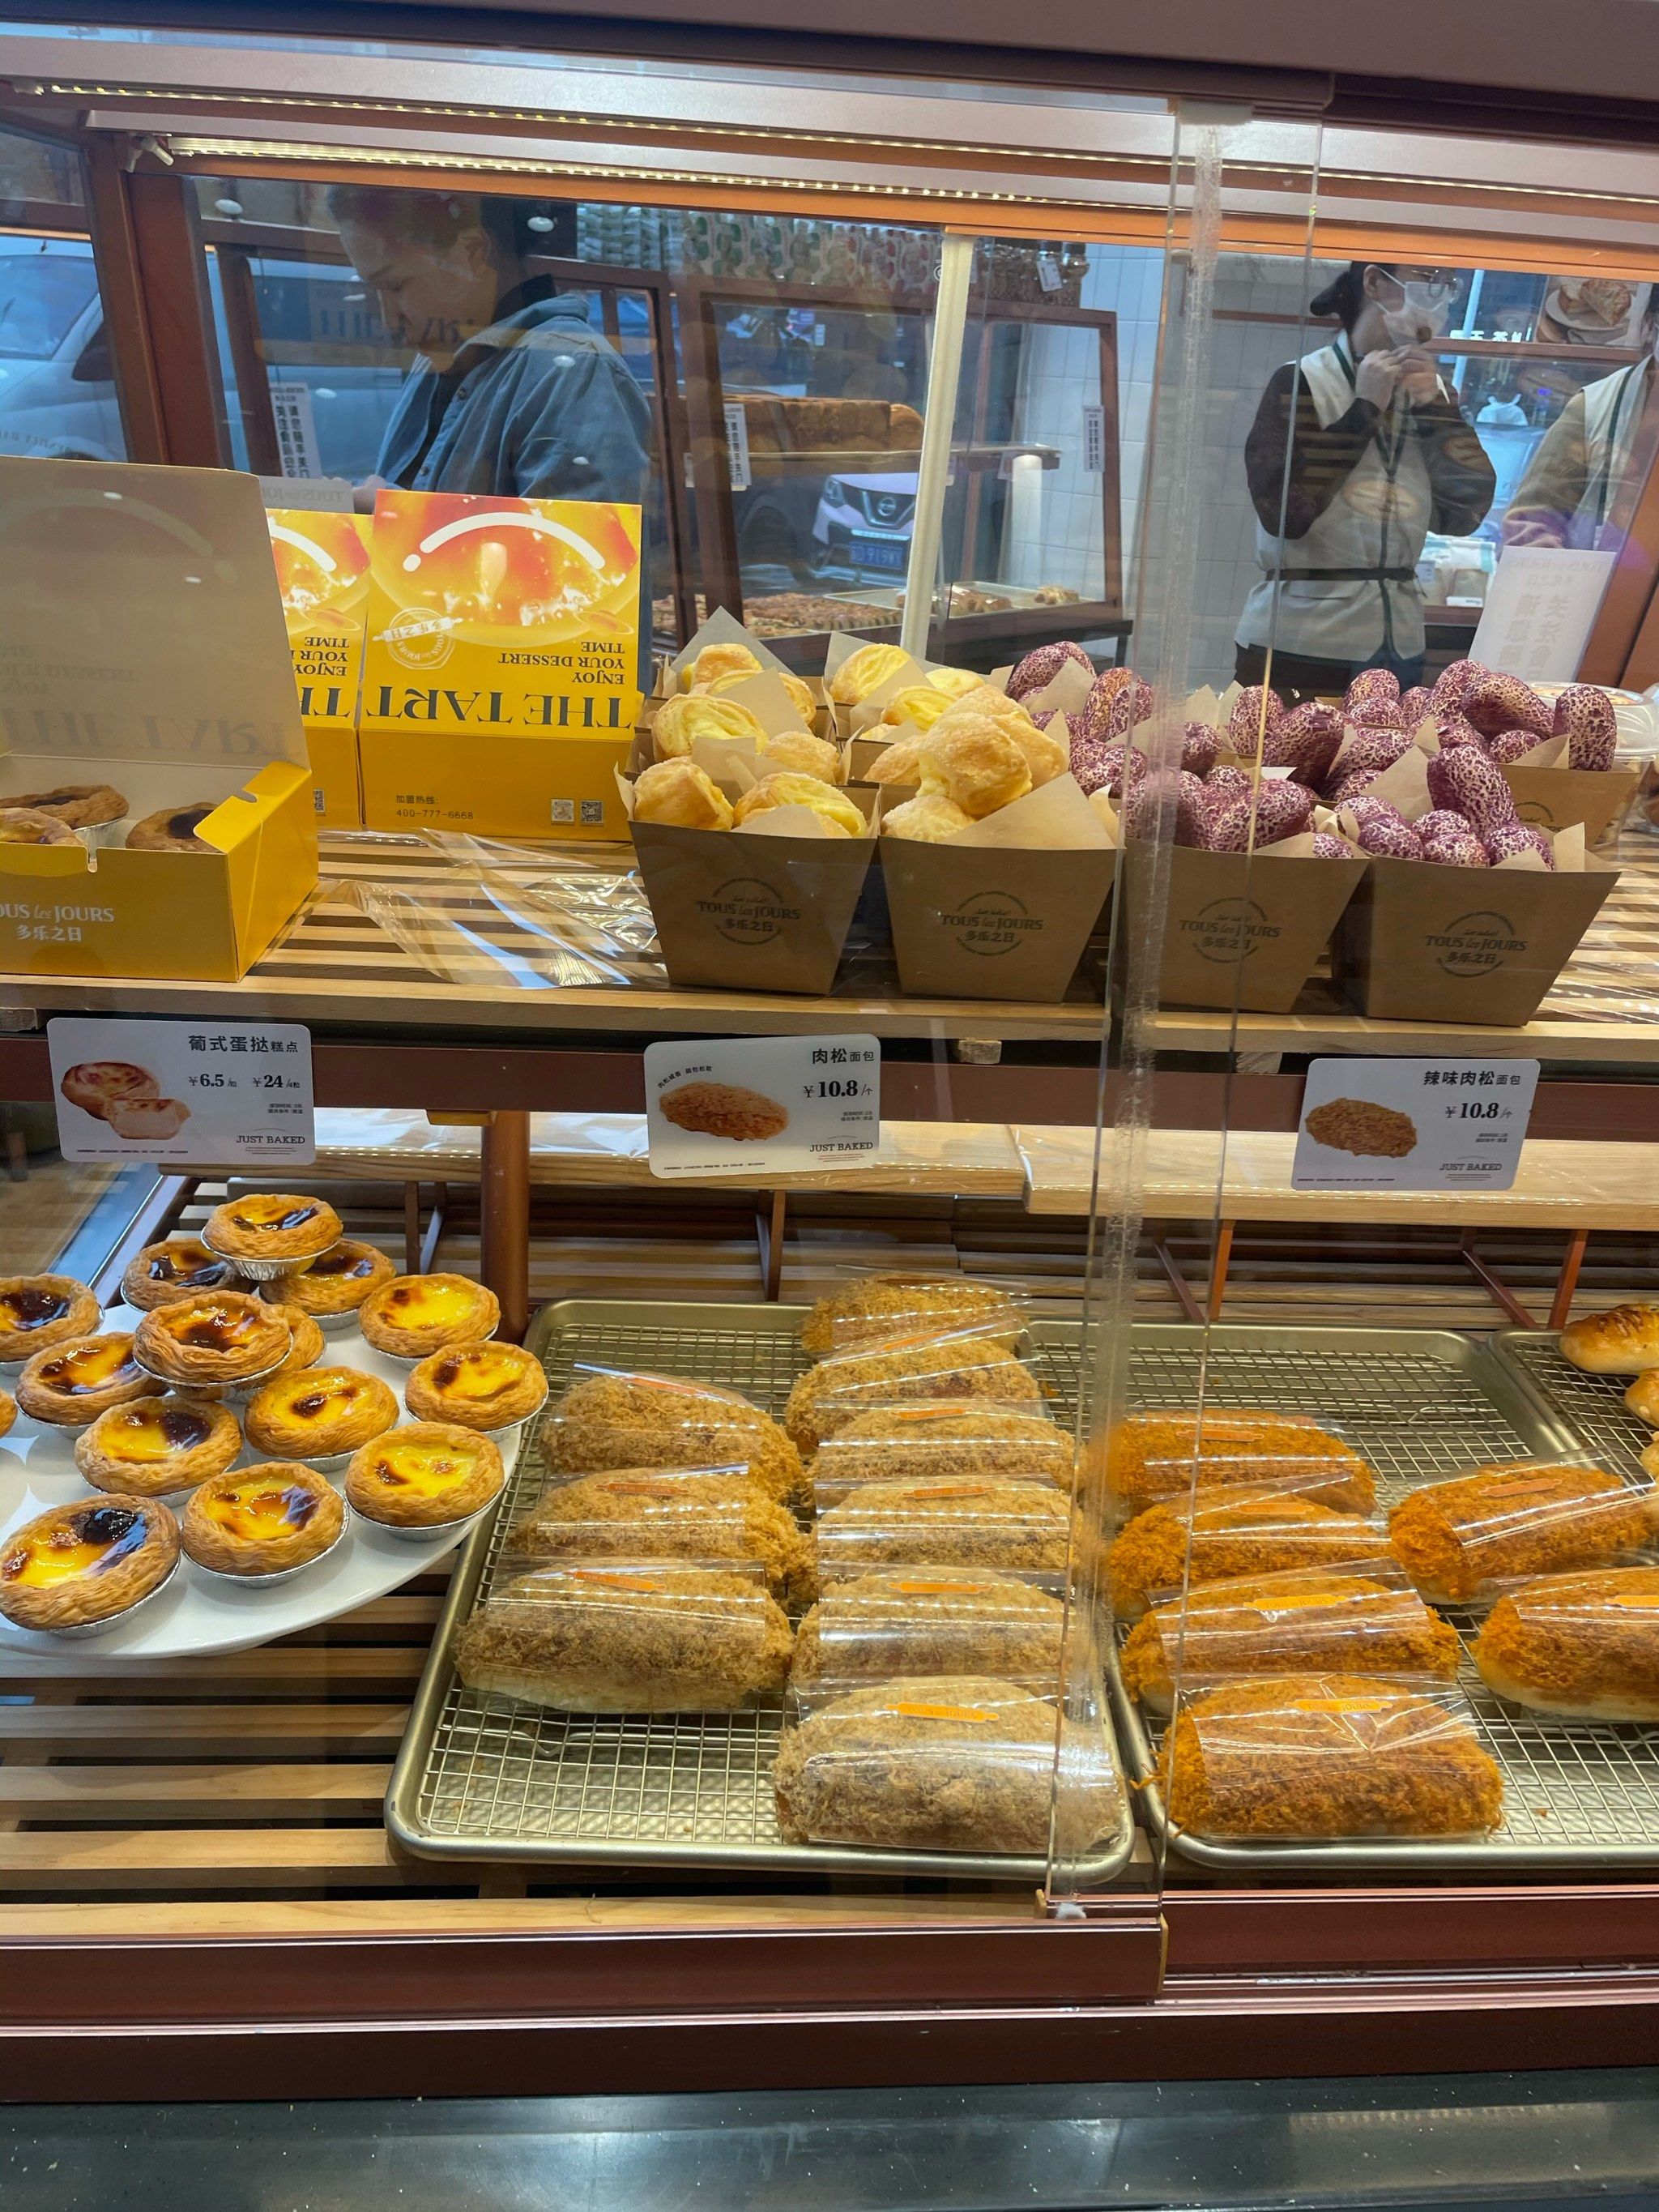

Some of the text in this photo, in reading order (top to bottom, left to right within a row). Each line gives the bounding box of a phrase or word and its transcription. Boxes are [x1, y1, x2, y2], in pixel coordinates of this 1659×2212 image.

[305, 636, 350, 648] TIME
[581, 641, 625, 654] TIME
[300, 650, 348, 662] YOUR
[498, 652, 625, 669] YOUR DESSERT
[572, 670, 625, 685] ENJOY
[366, 685, 513, 724] TART
[523, 693, 632, 729] THE
[395, 809, 475, 820] 400-777-6668
[34, 904, 52, 920] les
[53, 905, 115, 923] JOURS
[697, 900, 736, 915] TOUS
[754, 906, 801, 920] JOURS
[940, 914, 980, 927] TOUS
[997, 917, 1044, 931] JOURS
[1179, 919, 1218, 933] TOUS
[16, 924, 83, 942] 多乐之日
[965, 929, 1016, 942] 多乐之日
[1426, 935, 1465, 947] TOUS
[1480, 938, 1529, 951] JOURS
[812, 1048, 875, 1065] 肉松面包
[1422, 1070, 1521, 1087] 辣味肉松面包
[236, 1135, 305, 1144] JUST BAKED
[810, 1142, 873, 1152] JUST BAKED
[1439, 1163, 1503, 1172] JUST BAKED
